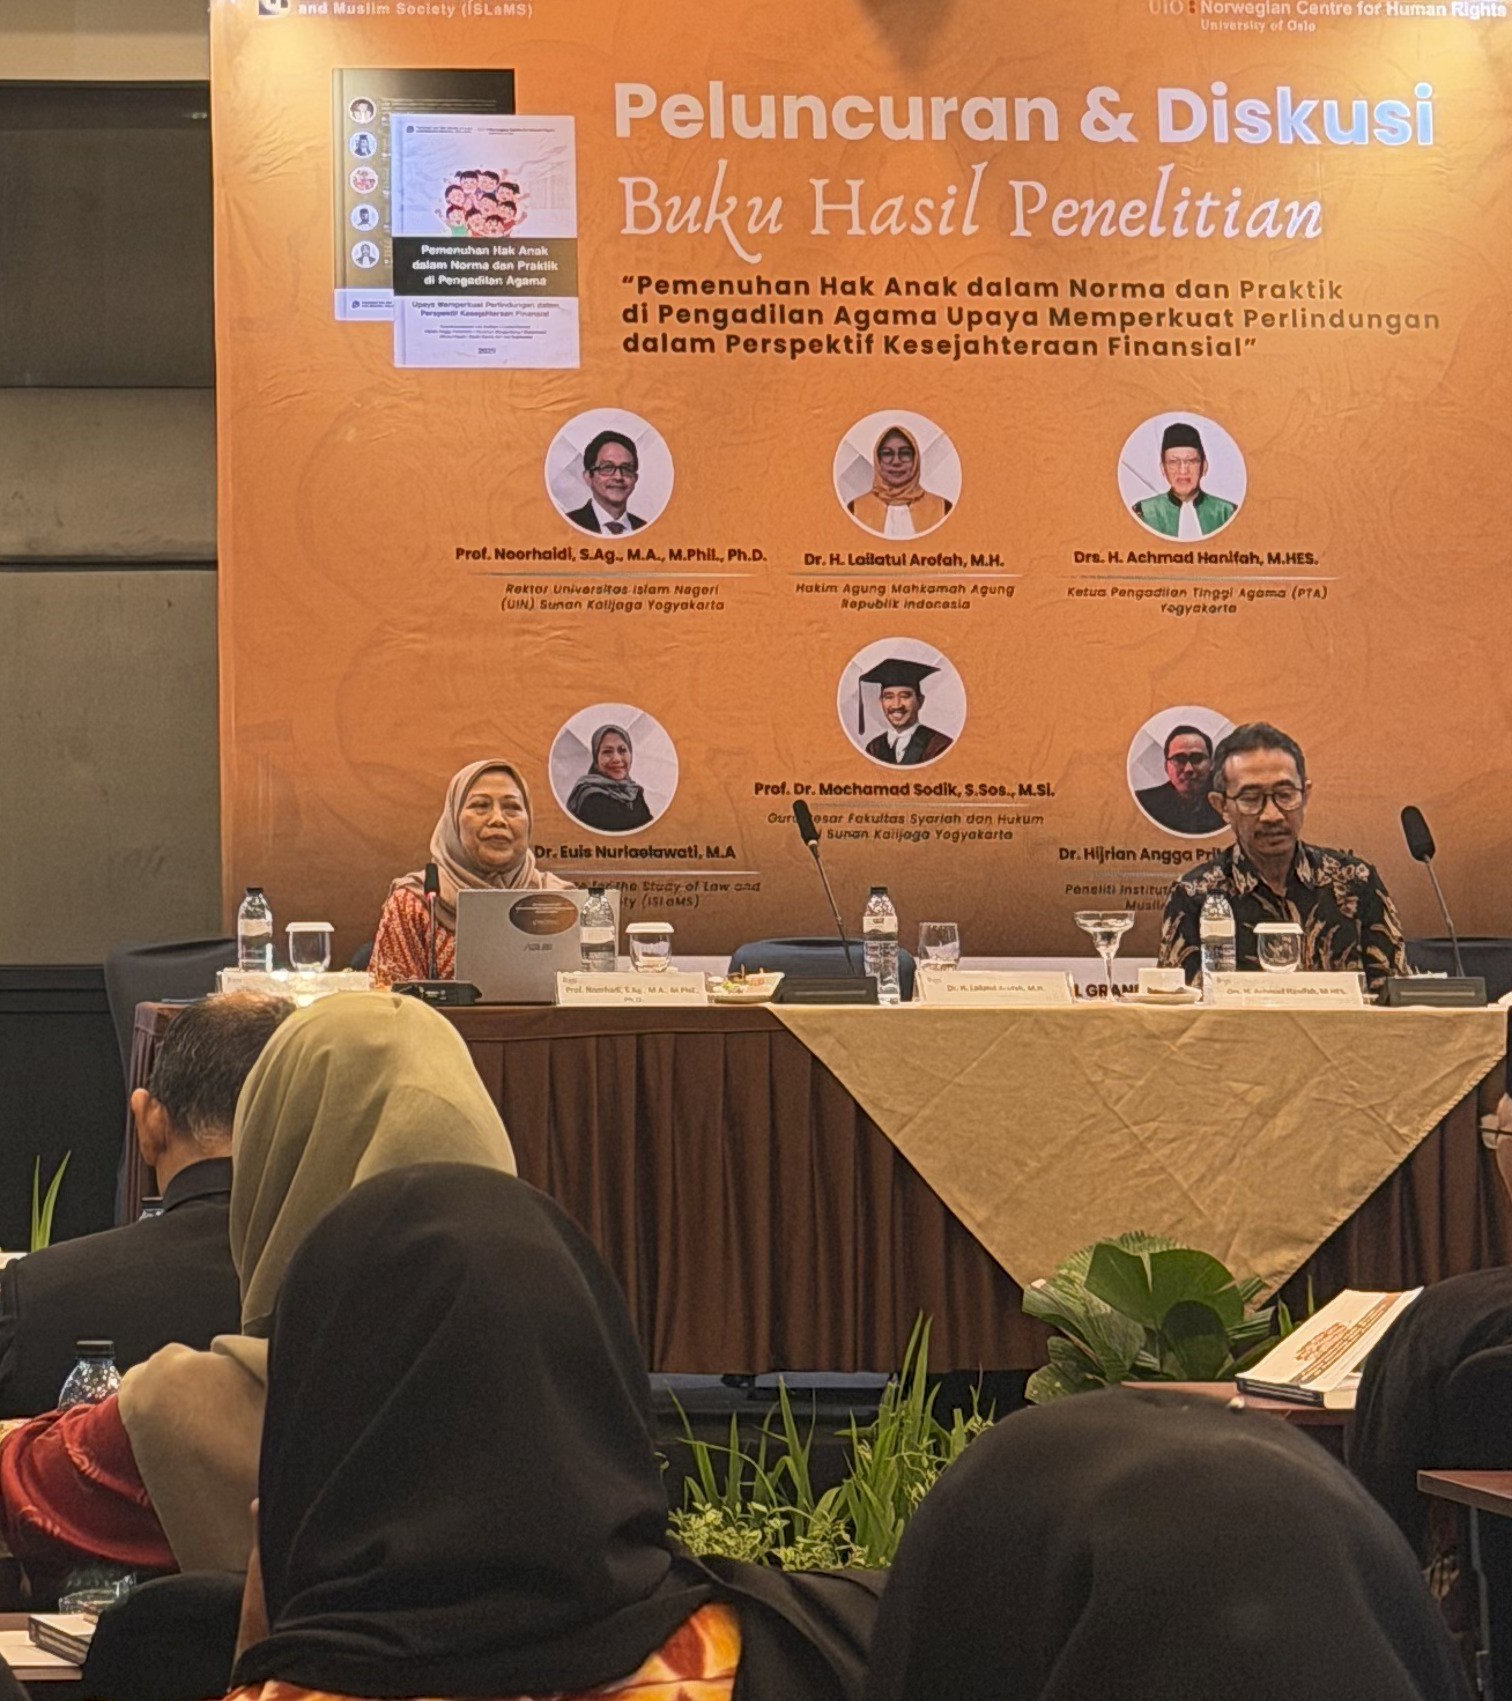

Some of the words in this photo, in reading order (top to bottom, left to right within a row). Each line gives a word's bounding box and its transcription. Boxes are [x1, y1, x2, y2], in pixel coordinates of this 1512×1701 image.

[298, 1, 328, 15] and
[333, 1, 390, 14] Muslim
[396, 1, 455, 17] Society
[1201, 0, 1290, 17] Norwegian
[1296, 0, 1352, 16] Centre
[1357, 0, 1381, 16] for
[1387, 0, 1446, 16] Human
[1451, 0, 1506, 20] Rights
[615, 80, 1059, 142] Peluncuran
[1080, 86, 1138, 143] &
[1157, 81, 1434, 146] Diskusi
[617, 159, 783, 264] Buku
[809, 161, 988, 237] Hasil
[1008, 162, 1323, 239] Penelitian
[820, 276, 875, 297] Hak
[885, 276, 958, 297] Anak
[967, 276, 1059, 298] dalam
[1069, 278, 1165, 299] Norma
[1175, 278, 1230, 299] dan
[1239, 278, 1343, 300] Praktik
[621, 302, 649, 325] di
[658, 302, 824, 330] Pengadilan
[833, 305, 937, 331] Agama
[947, 306, 1039, 332] Upaya
[1049, 306, 1234, 332] Memperkuat
[1243, 307, 1440, 335] Perlindungan
[622, 331, 715, 354] dalam
[725, 332, 875, 359] Perspektif
[884, 333, 1098, 361] Kesejahteraan
[455, 547, 491, 561] Prof.
[494, 547, 576, 563] Noorhaidi,
[728, 548, 767, 562] Ph.D.
[804, 553, 826, 566] Dr.
[829, 554, 845, 566] H.
[909, 553, 967, 568] Arofah,
[971, 554, 1005, 567] M.H.
[1074, 551, 1105, 563] Drs.
[1108, 551, 1123, 564] H.
[1127, 551, 1194, 565] Achmad
[1197, 551, 1263, 567] Hanifah,
[1267, 552, 1319, 566] M.HES.
[754, 781, 791, 796] Prof.
[794, 783, 816, 796] Dr.
[819, 783, 910, 796] Mochamad
[913, 783, 962, 799] Sodik,
[811, 814, 843, 824] esar
[1059, 847, 1082, 860] Dr.
[1084, 846, 1137, 864] Hijrian
[1140, 847, 1193, 865] Angga
[1120, 884, 1172, 895] Institut
